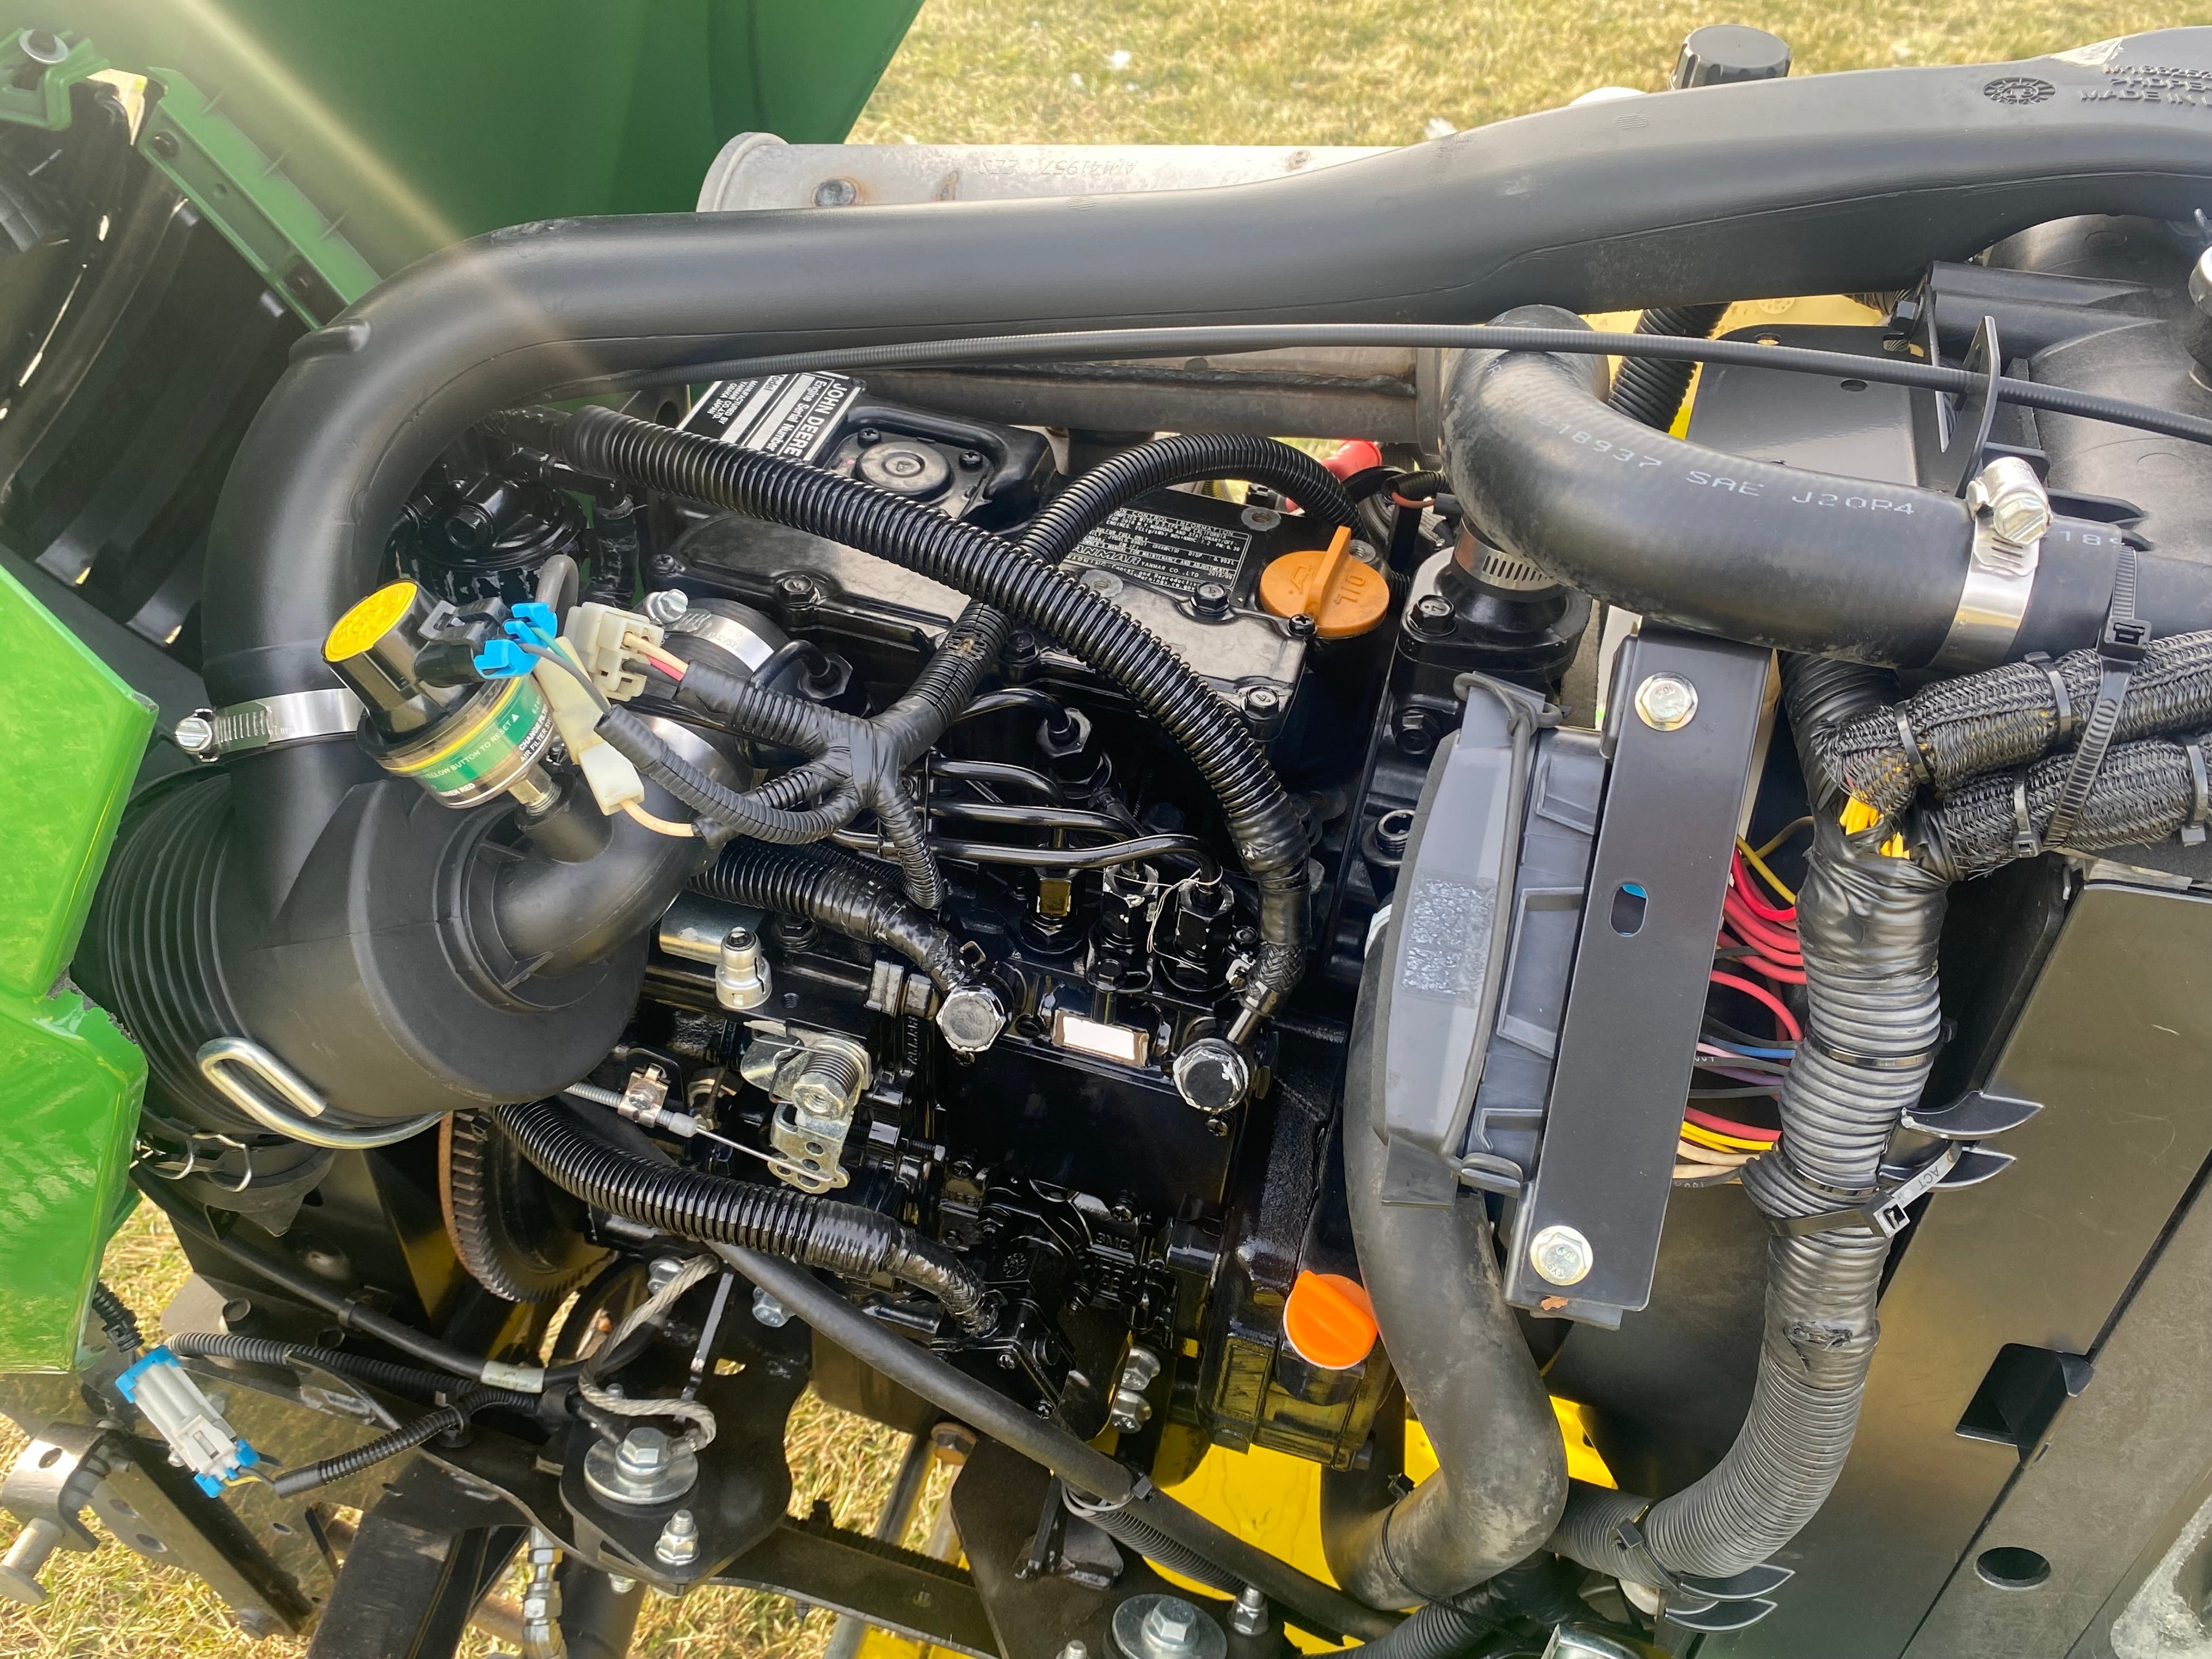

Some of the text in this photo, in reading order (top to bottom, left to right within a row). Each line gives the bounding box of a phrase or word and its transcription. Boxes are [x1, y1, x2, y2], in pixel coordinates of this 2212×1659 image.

[2078, 89, 2161, 101] MADE
[2166, 92, 2196, 105] IN
[706, 384, 738, 415] OSAKA JAPAN
[724, 380, 758, 416] MANUFACTURED
[727, 381, 748, 400] YANMAR
[765, 380, 827, 450] Engine Serial Number
[783, 382, 847, 457] JOHN DEERE
[1685, 470, 1915, 516] SAE J20R4
[1095, 526, 1116, 535] SULFUR
[1131, 511, 1167, 522] CONTROL
[1176, 520, 1234, 536] INFORMATION
[1192, 528, 1227, 539] CALIFORNIA
[1107, 543, 1127, 552] MANUAL
[1141, 551, 1177, 563] MAINTENANCE
[1141, 560, 1166, 571] YANMAR
[1334, 575, 1365, 607] OIL
[449, 750, 481, 771] BUTTON
[479, 741, 491, 752] TO
[490, 719, 512, 744] RESET
[518, 721, 541, 751] CHANGE
[520, 728, 548, 763] AIR FILTER
[459, 782, 476, 794] RED
[1917, 1165, 1942, 1191] ACT
